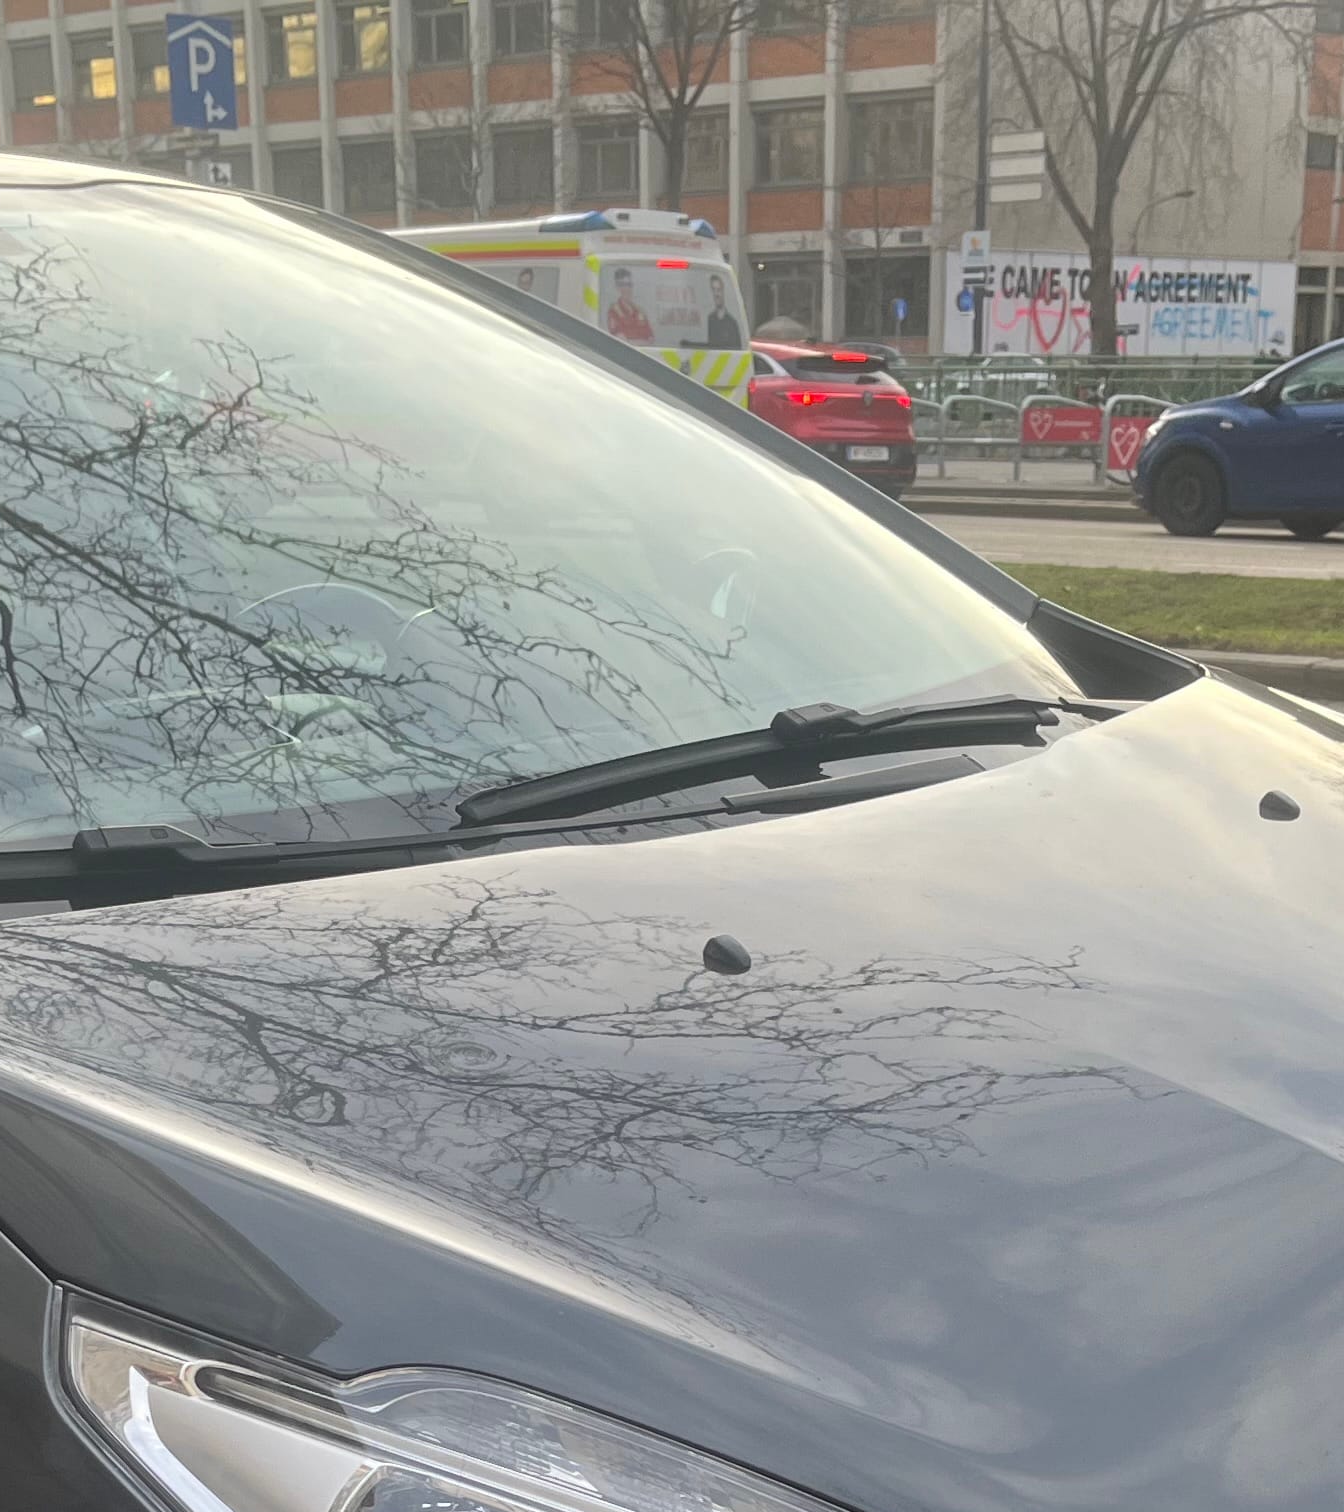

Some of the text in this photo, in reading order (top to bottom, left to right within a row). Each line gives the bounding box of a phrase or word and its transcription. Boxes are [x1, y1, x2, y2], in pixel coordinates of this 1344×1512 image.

[188, 38, 216, 91] P
[1001, 265, 1061, 300] CAME
[1134, 272, 1253, 304] AGREEMENT
[1152, 305, 1275, 342] AGREEMENT
